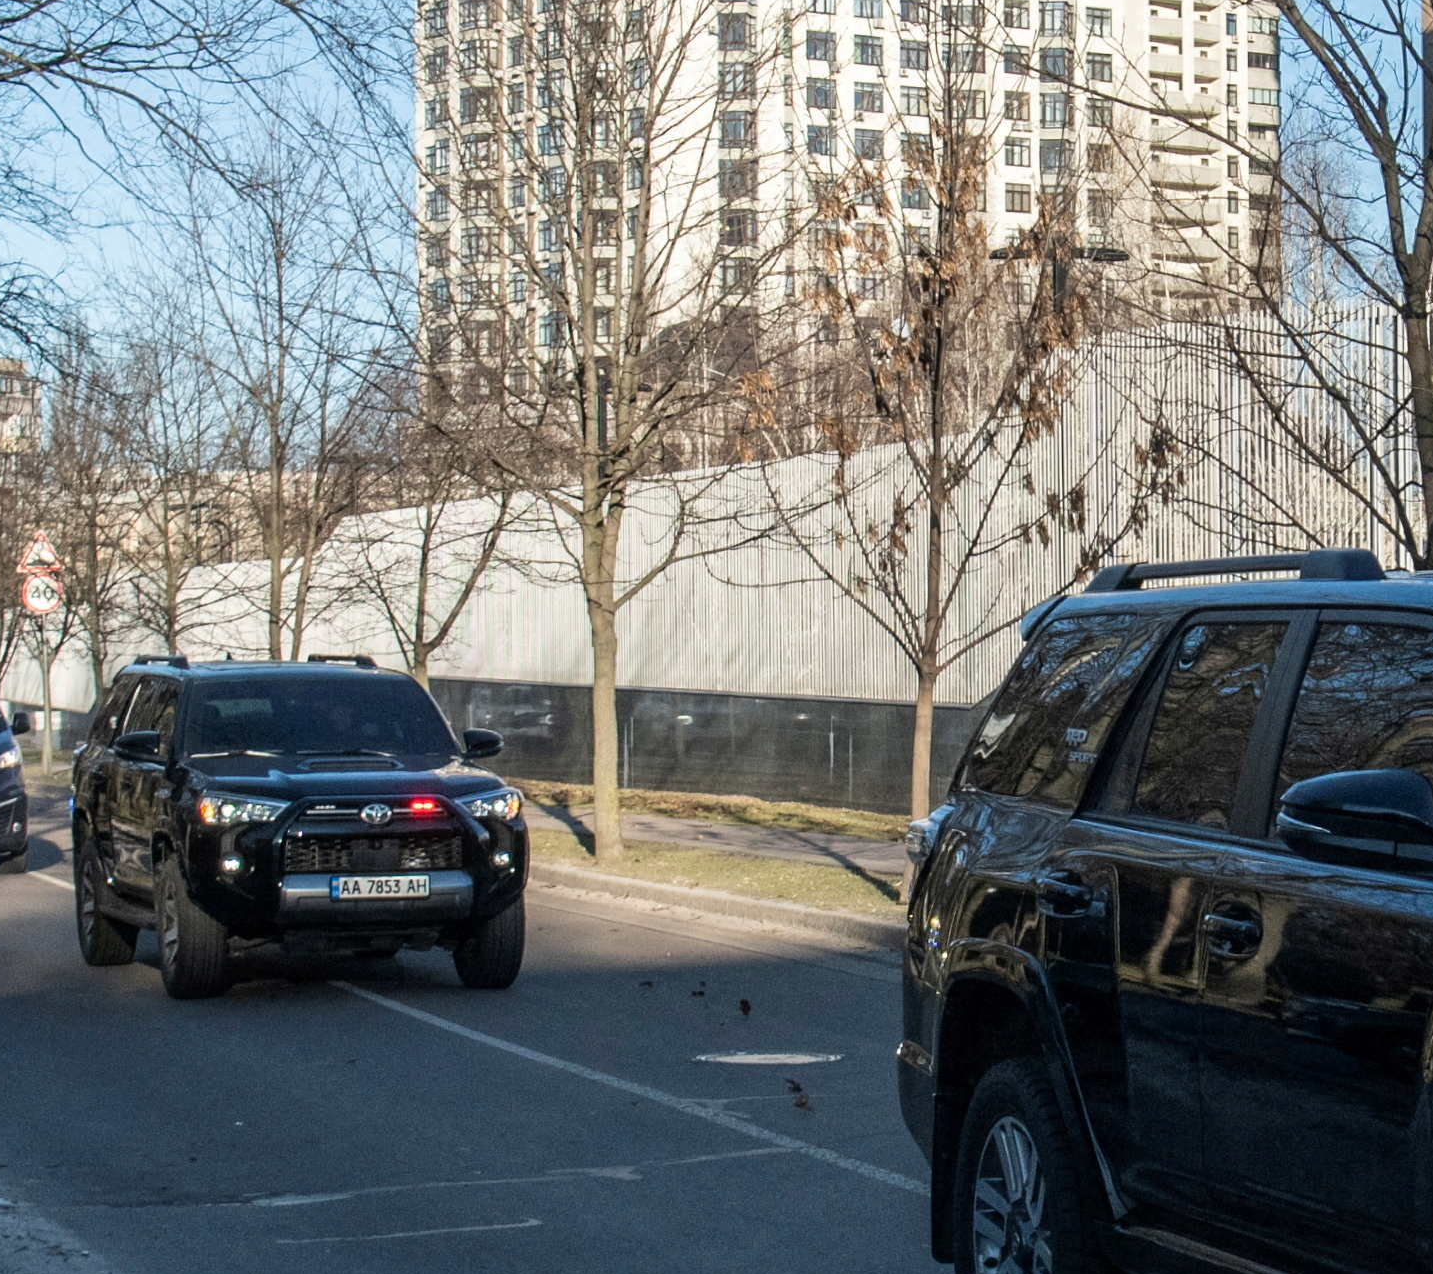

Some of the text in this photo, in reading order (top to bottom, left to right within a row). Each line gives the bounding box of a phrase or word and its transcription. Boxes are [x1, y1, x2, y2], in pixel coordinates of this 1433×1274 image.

[30, 585, 55, 601] 40
[341, 880, 362, 895] AA
[367, 879, 401, 895] 7853
[406, 878, 427, 893] AH
